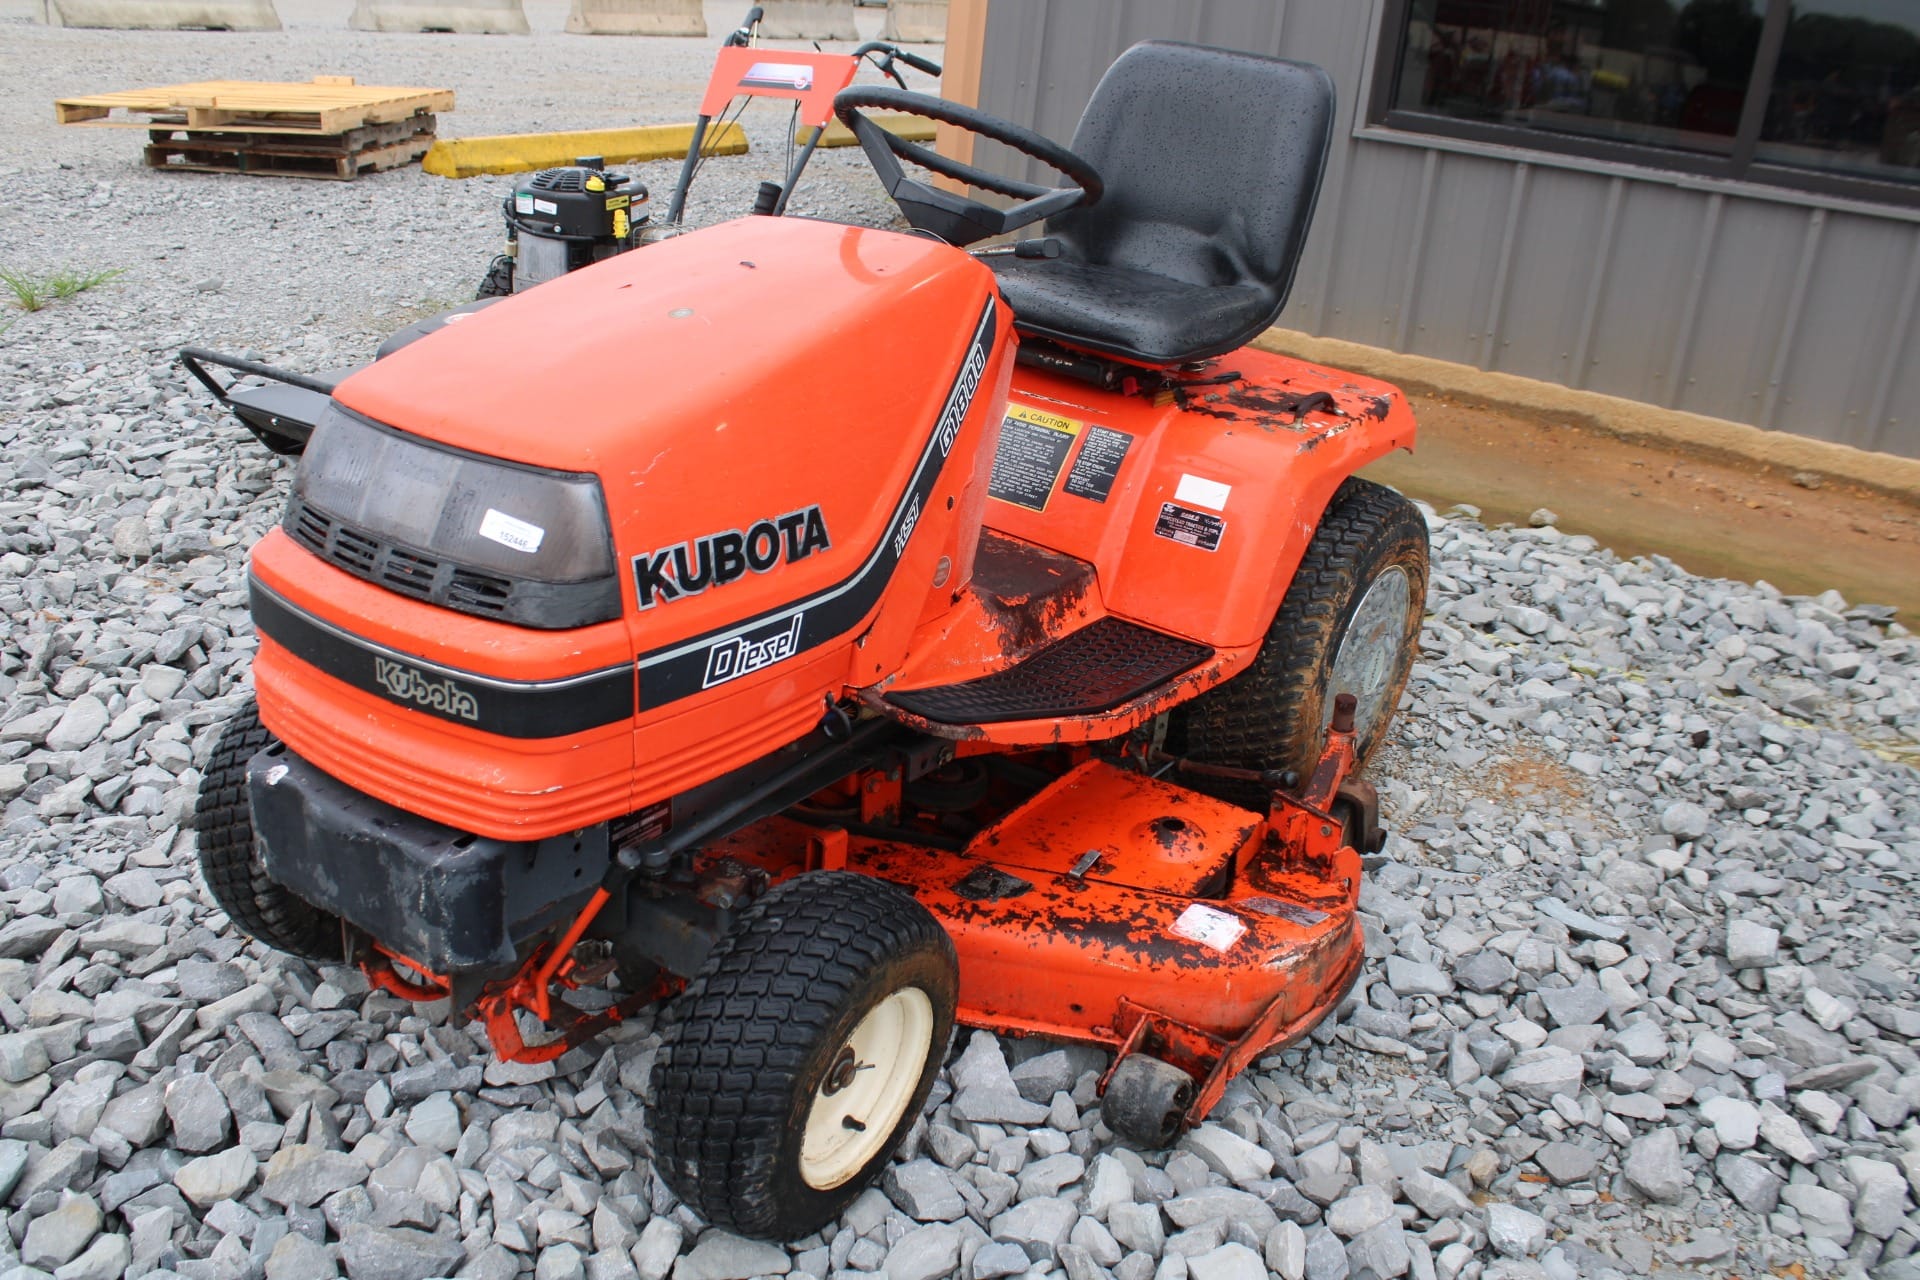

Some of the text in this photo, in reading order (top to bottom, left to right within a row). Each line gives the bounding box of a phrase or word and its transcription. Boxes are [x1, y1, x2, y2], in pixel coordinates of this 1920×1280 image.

[939, 343, 986, 458] G1800
[1030, 413, 1070, 429] CAUTION
[631, 503, 832, 611] KUBOTA
[893, 492, 921, 560] HST
[702, 612, 803, 690] Diesel
[375, 656, 479, 721] Kubota
